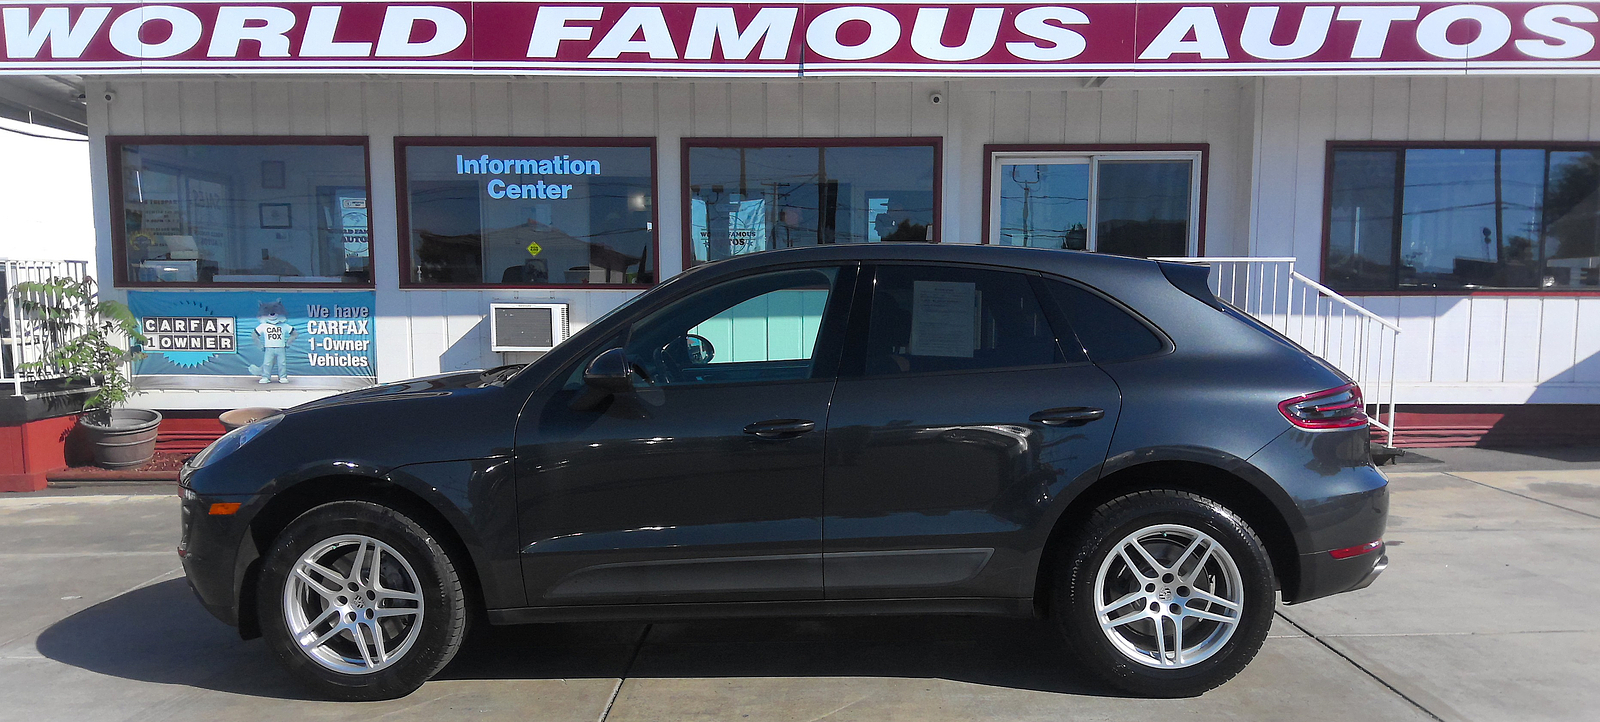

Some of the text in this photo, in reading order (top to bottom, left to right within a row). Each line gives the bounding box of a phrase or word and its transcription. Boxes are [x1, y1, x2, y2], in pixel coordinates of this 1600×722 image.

[2, 5, 1597, 61] WORLD FAMOUS AUTOS
[456, 154, 601, 175] Information
[487, 179, 573, 199] Center
[307, 304, 369, 318] We have
[147, 319, 231, 334] CARFAX
[307, 320, 369, 335] CARFAX
[147, 337, 231, 349] 1 OWNER
[308, 337, 369, 351] 1-Owner
[308, 353, 369, 367] Vehicles
